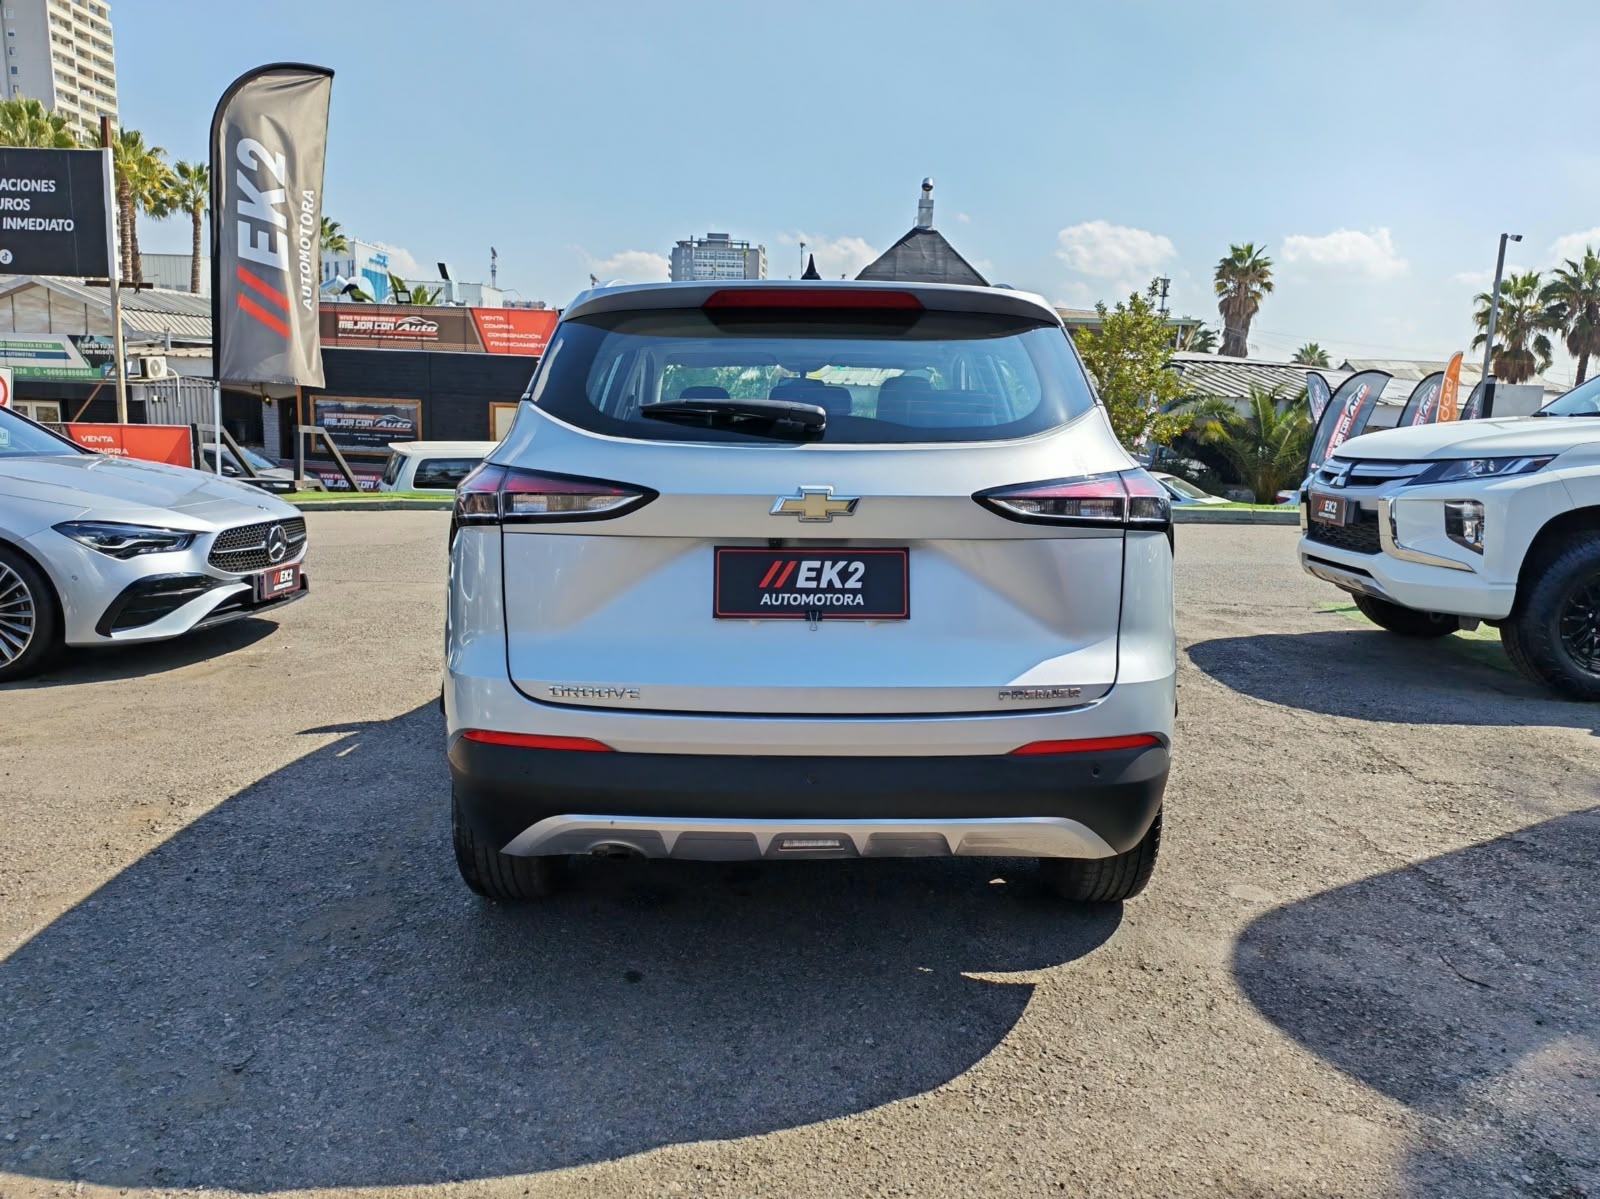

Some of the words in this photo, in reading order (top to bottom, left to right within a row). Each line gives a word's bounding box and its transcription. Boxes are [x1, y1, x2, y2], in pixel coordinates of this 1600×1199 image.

[0, 178, 56, 192] ACIONES
[236, 138, 289, 272] EK2
[2, 216, 75, 232] INMEDIATO
[300, 190, 315, 311] AUTOMOTORA
[338, 321, 373, 330] MEJOR
[374, 321, 395, 330] CON
[397, 323, 437, 332] Auto
[324, 418, 354, 426] MEJOR
[355, 419, 373, 427] CON
[81, 435, 114, 443] VENTA
[88, 447, 129, 455] OMPRA
[1325, 500, 1338, 514] EK2
[280, 568, 294, 583] EK2
[796, 560, 866, 589] EK2
[760, 593, 865, 606] AUTOMOTORA
